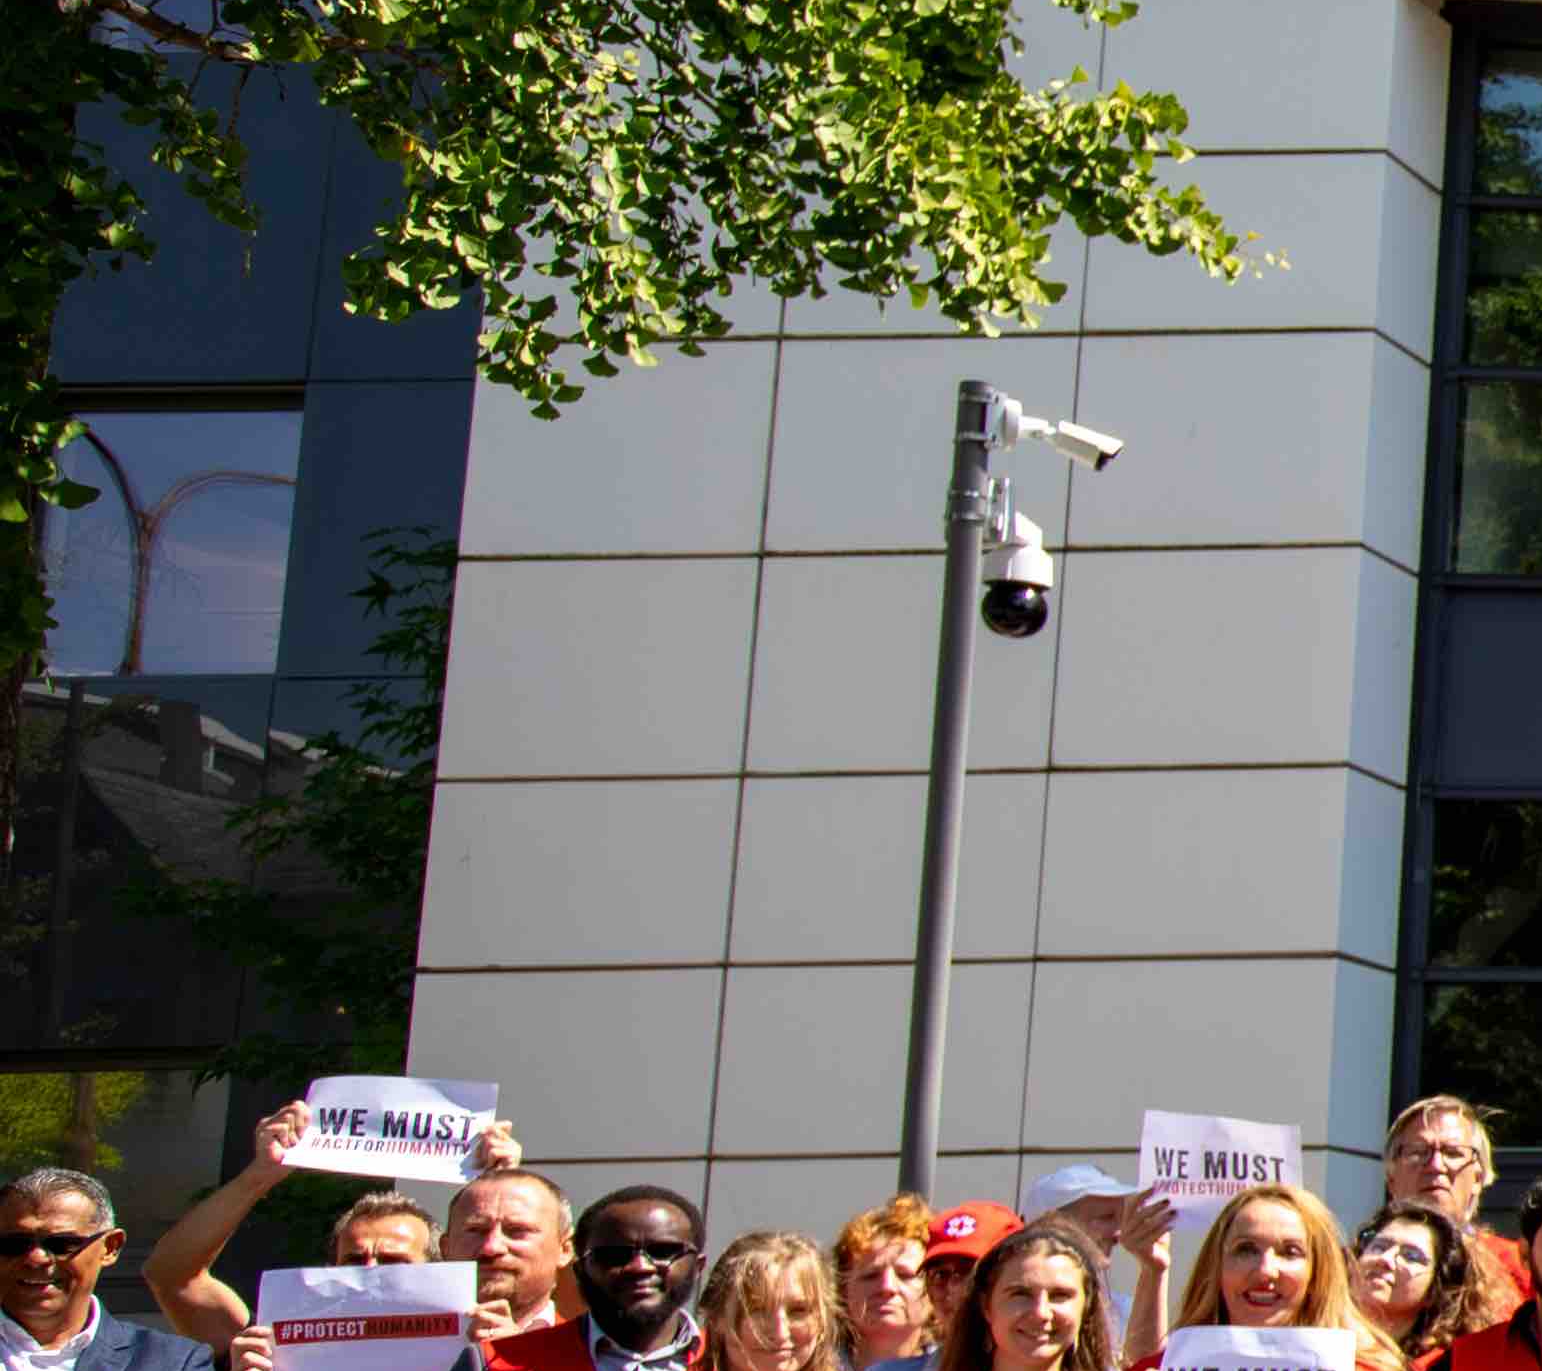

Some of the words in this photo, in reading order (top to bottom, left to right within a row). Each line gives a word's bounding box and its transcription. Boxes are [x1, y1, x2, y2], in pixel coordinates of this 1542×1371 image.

[319, 1107, 368, 1137] WE
[383, 1109, 476, 1141] MUST
[311, 1138, 470, 1156] #ACTFORHUMANITY
[1154, 1147, 1189, 1179] WE
[1203, 1151, 1285, 1182] MUST
[281, 1316, 454, 1340] #PROTECTHUMANITY
